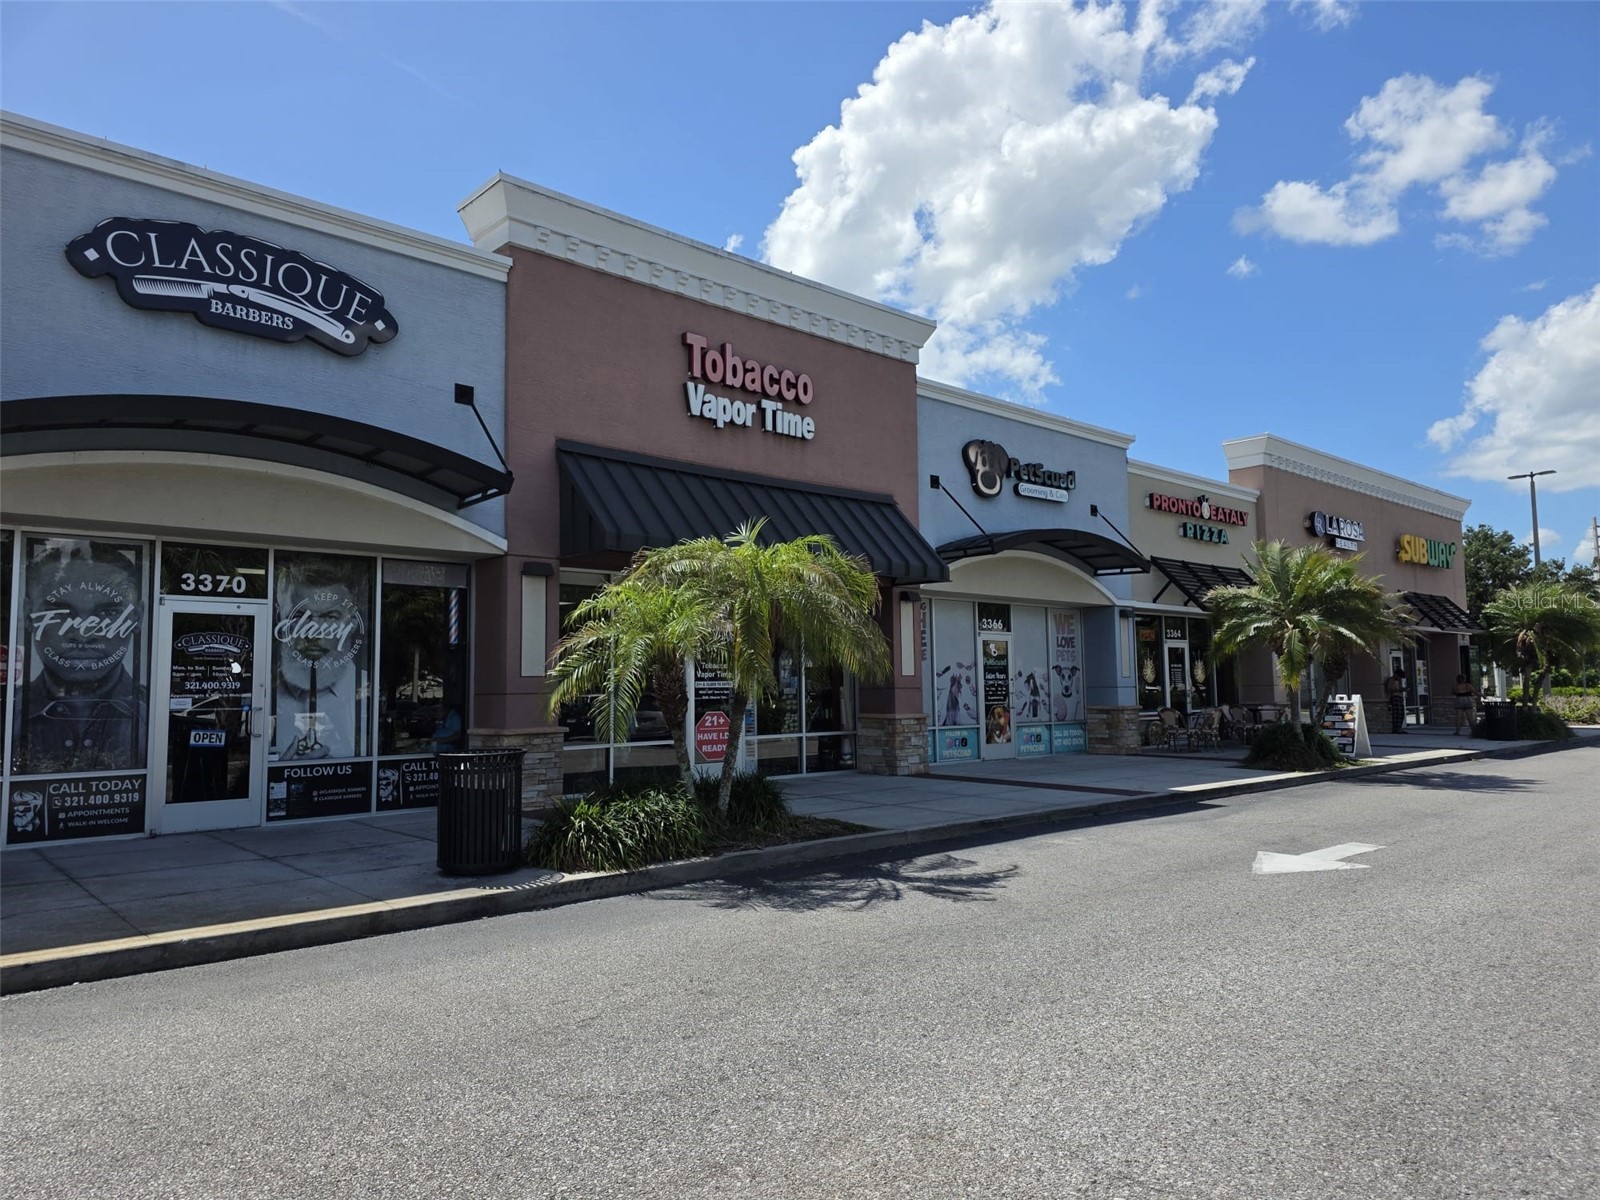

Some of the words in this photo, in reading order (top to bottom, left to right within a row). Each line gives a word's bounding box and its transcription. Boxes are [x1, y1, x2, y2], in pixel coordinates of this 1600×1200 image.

[105, 230, 373, 327] CLASSIQUE
[209, 299, 294, 331] BARBERS
[682, 331, 814, 405] Tobacco
[685, 381, 757, 429] Vapor
[760, 398, 816, 440] Time
[1007, 456, 1076, 490] PetScuad
[1020, 484, 1049, 499] Grooming
[1150, 492, 1201, 518] PRONTO
[1209, 504, 1249, 526] EATALY
[1184, 521, 1229, 544] PIZZA
[1398, 534, 1457, 570] SUBWAY
[180, 573, 247, 594] 3370
[46, 583, 74, 604] STAY
[79, 581, 123, 603] ALWAYS
[313, 592, 339, 601] KEEP
[30, 603, 138, 641] Fresh
[981, 618, 1004, 630] 3366
[274, 609, 355, 652] Classy
[1166, 629, 1182, 639] 3364
[181, 634, 246, 649] CLASSIQUE
[1056, 636, 1076, 649] LOVE
[44, 646, 71, 668] CLASS
[91, 645, 128, 670] BARBERS
[291, 649, 320, 670] CLASS
[332, 638, 363, 669] BARBERS
[696, 671, 716, 680] Vapor
[184, 681, 241, 690] 321.400.9319
[705, 716, 725, 727] 21+
[193, 732, 223, 744] OPEN
[697, 732, 718, 741] HAVE
[702, 743, 727, 753] READY
[283, 766, 336, 779] FOLLOW
[337, 765, 352, 775] US
[402, 761, 428, 772] CALL
[413, 772, 439, 782] 321.40
[49, 783, 87, 795] CALL
[90, 779, 142, 792] TODAY
[64, 792, 140, 807] 321.400.9319
[67, 807, 130, 818] APPOINTMENTS
[67, 819, 96, 828] WALK-IN
[96, 817, 129, 826] WELCOME
